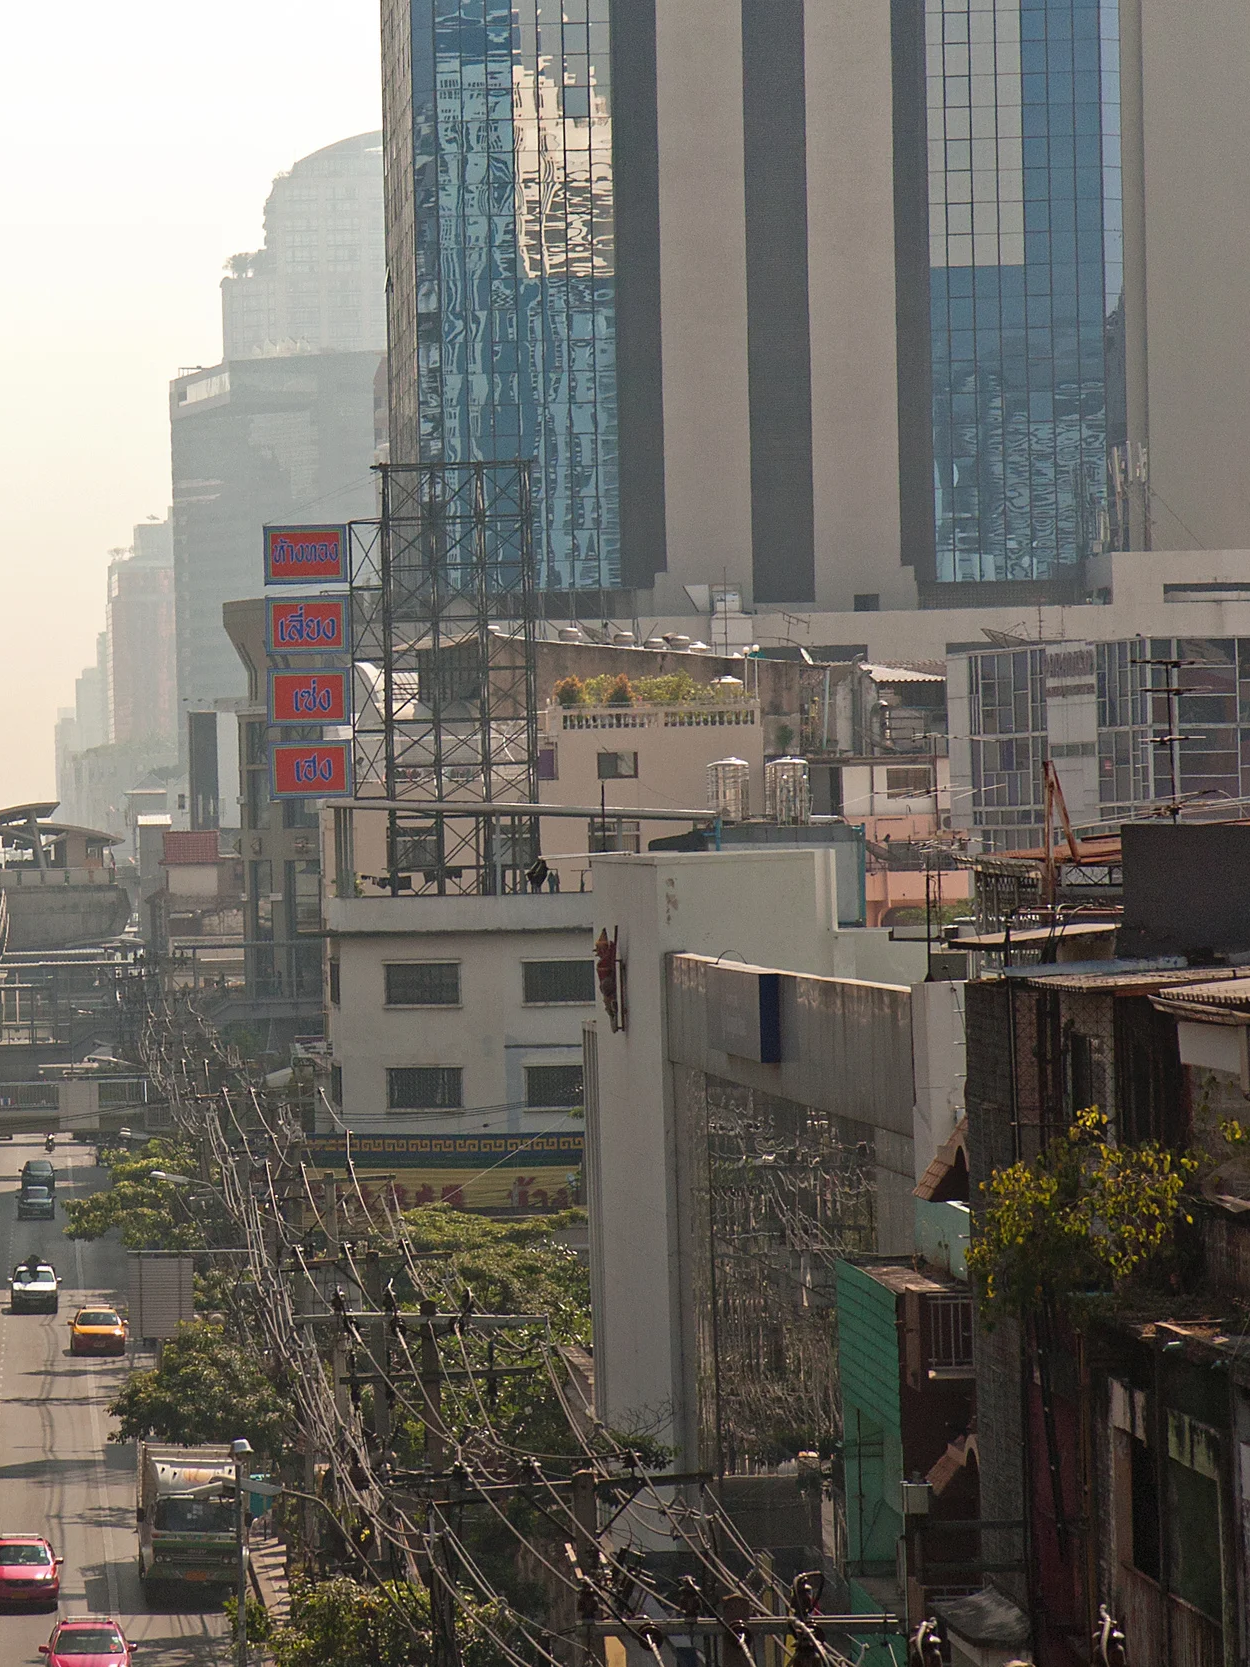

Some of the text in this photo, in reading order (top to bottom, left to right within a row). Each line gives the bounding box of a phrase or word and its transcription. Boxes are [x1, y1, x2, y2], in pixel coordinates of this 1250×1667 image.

[273, 538, 339, 564] ห้างทอง
[278, 605, 337, 642] เสี่ยง
[293, 679, 332, 713] เซ่ง
[294, 753, 333, 783] เฮง
